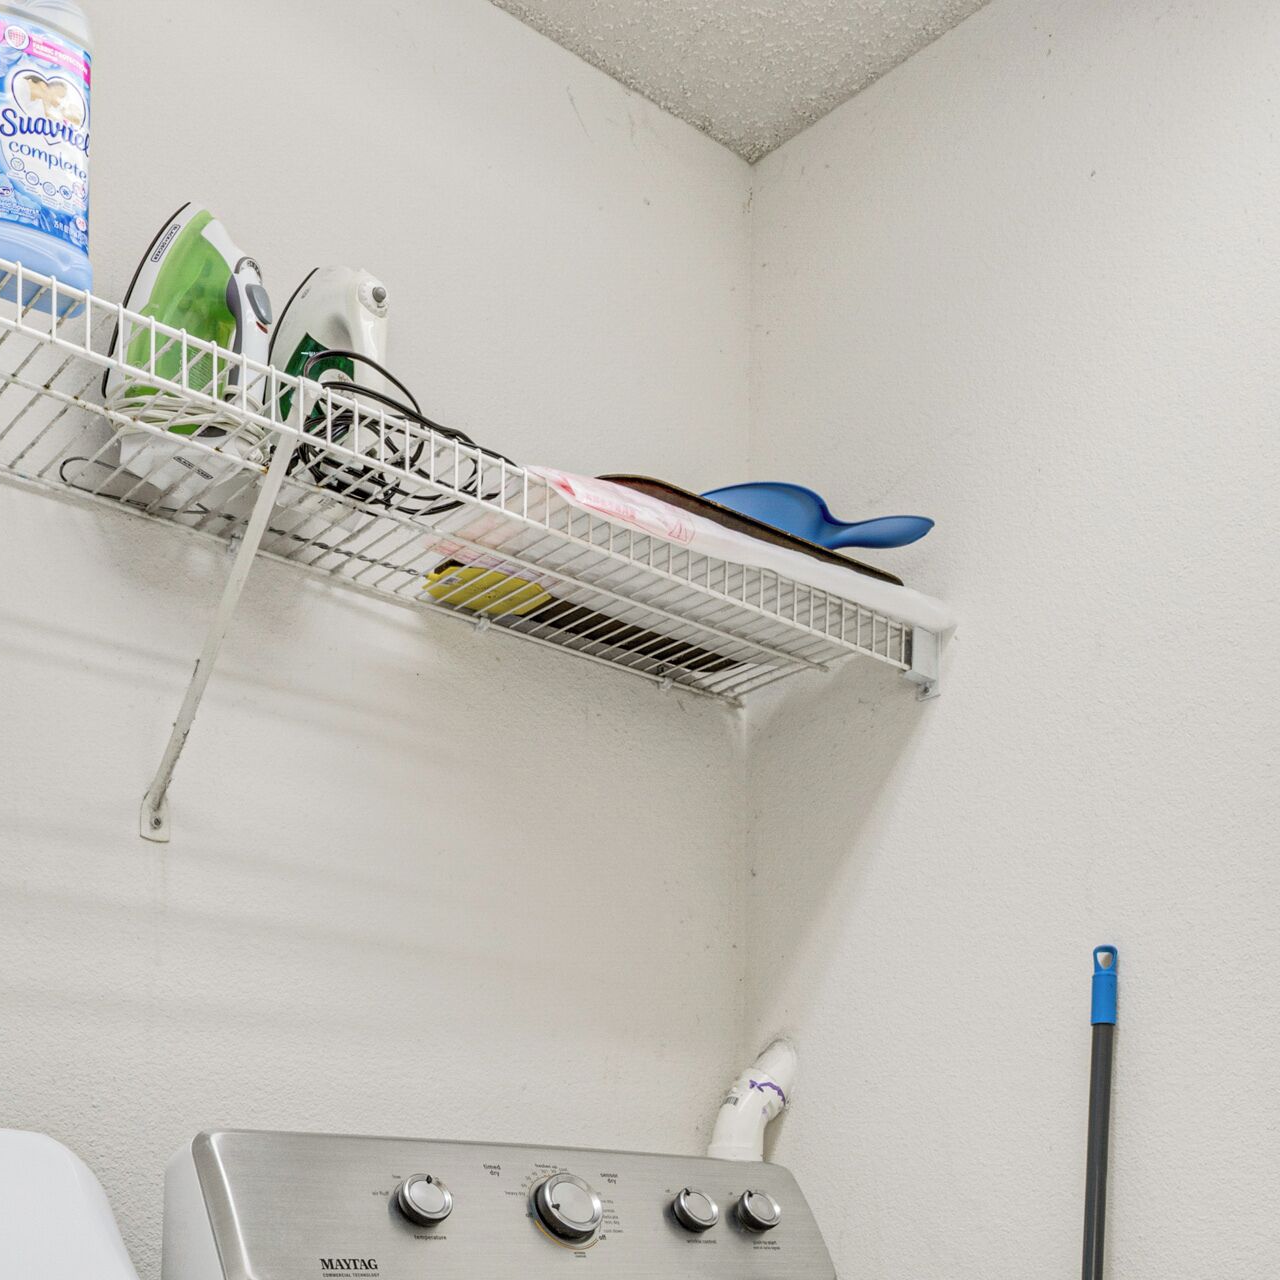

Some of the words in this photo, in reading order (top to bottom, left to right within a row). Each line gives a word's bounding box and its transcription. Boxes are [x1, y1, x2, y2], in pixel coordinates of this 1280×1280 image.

[0, 108, 89, 157] Suavitel
[9, 141, 87, 179] complete
[320, 1258, 378, 1270] MAYTAG
